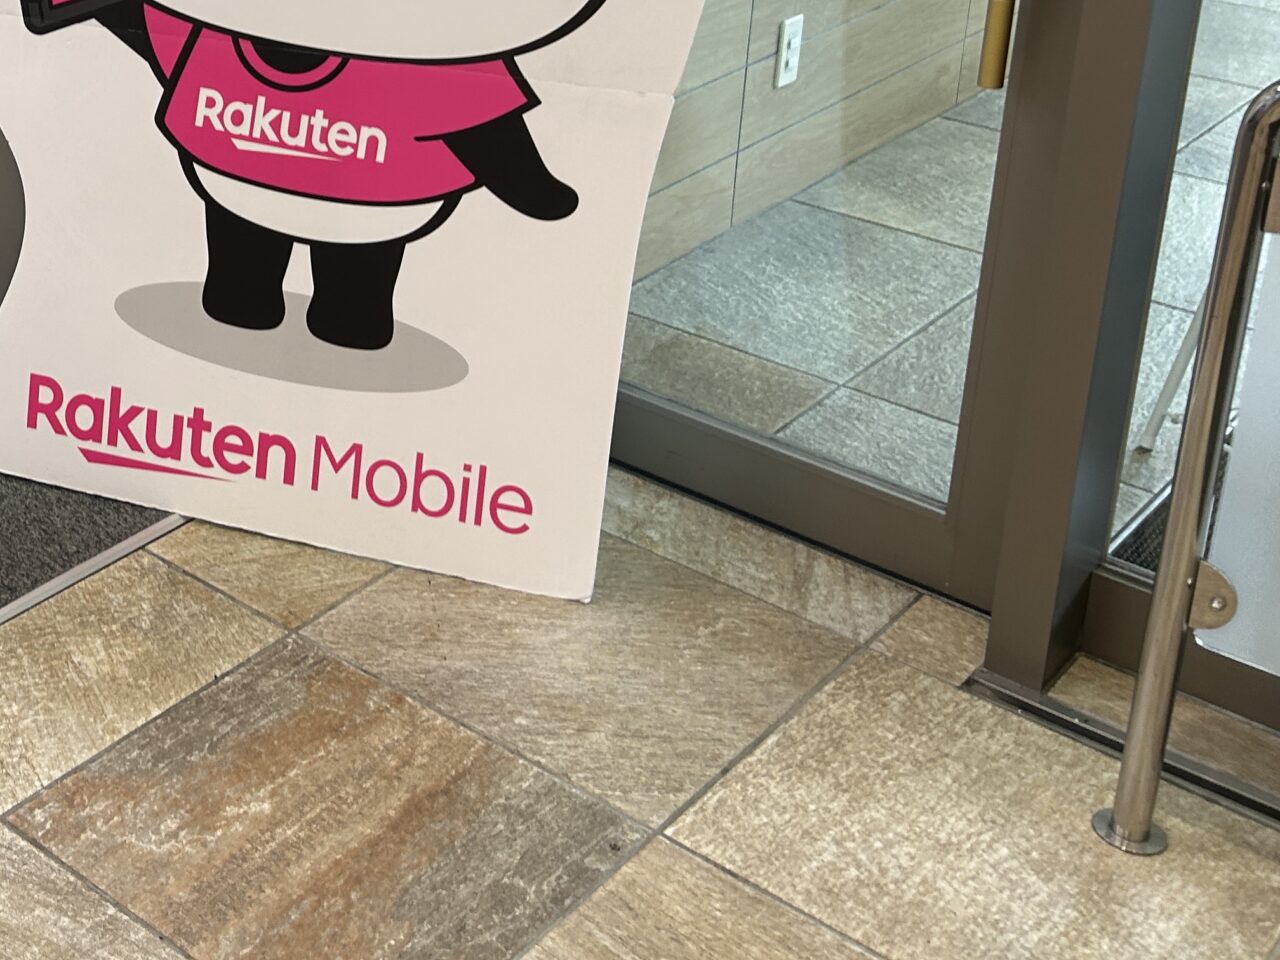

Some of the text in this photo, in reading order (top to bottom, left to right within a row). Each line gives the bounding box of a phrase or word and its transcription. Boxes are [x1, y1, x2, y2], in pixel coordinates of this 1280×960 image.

[194, 87, 387, 163] Rakuten
[26, 373, 533, 535] Rakuten Mobile
